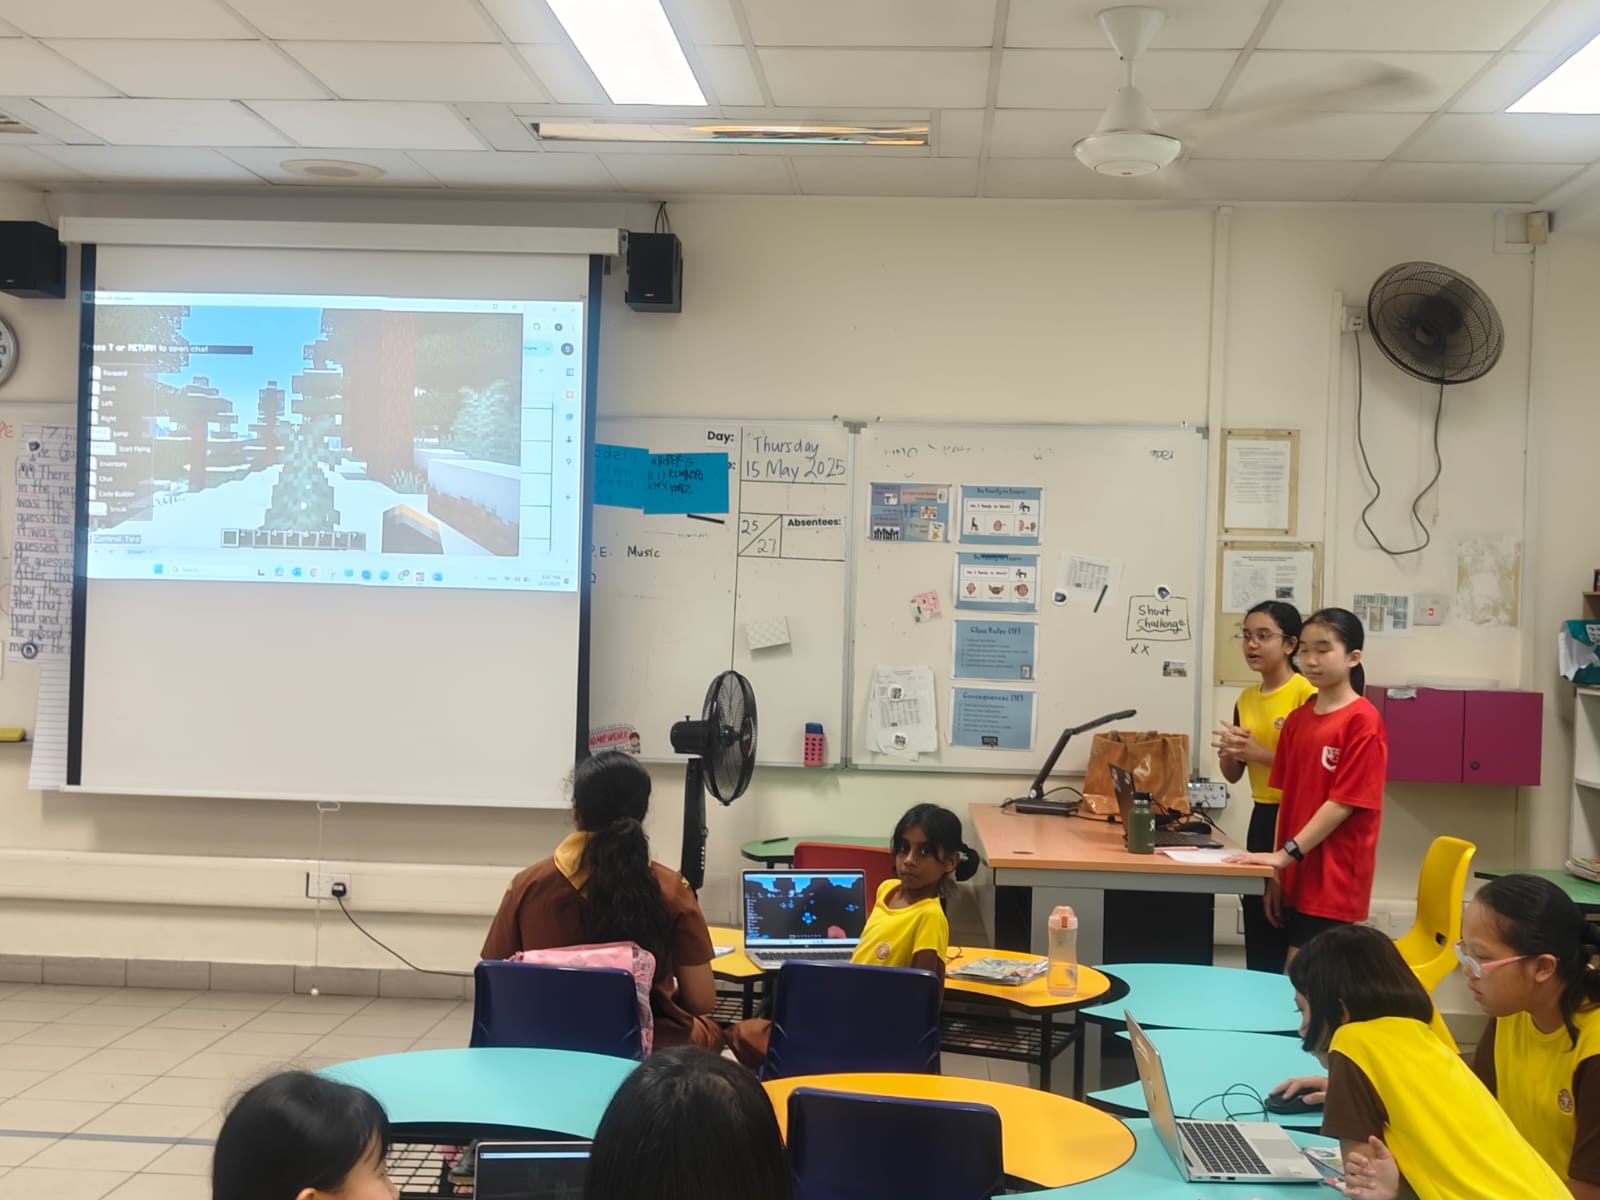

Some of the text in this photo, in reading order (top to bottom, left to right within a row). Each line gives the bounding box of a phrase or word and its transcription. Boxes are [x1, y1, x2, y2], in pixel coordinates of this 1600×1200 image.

[108, 343, 114, 352] T
[127, 343, 157, 353] RETURN
[158, 344, 168, 353] to
[168, 345, 189, 354] open
[190, 345, 209, 354] chat
[103, 369, 128, 377] Forward
[707, 430, 735, 445] Day:
[753, 436, 819, 459] Thursday
[98, 460, 128, 469] Inventory
[746, 460, 760, 478] 15
[766, 458, 800, 484] May
[803, 456, 847, 480] 2025
[98, 475, 113, 484] Chat
[98, 490, 136, 498] Code Builder
[741, 519, 759, 535] 25
[787, 517, 842, 528] Absentees:
[627, 545, 661, 558] Music
[757, 538, 776, 554] 27
[1138, 604, 1172, 617] Shout
[988, 626, 1007, 635] Rules
[1136, 617, 1187, 635] Challenge
[962, 691, 1009, 702] Consequences
